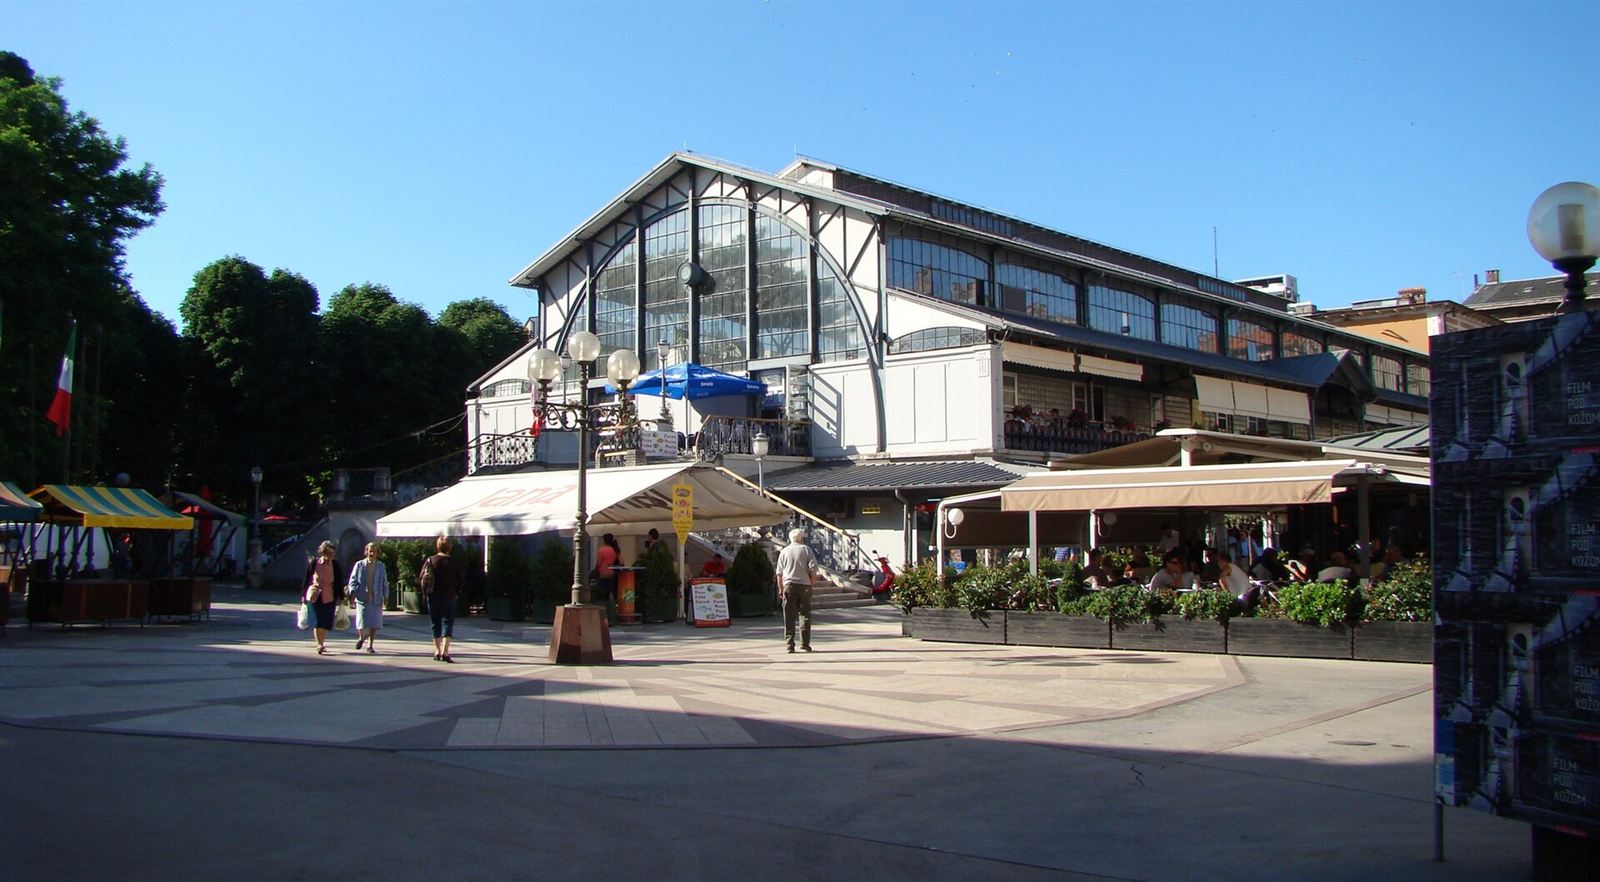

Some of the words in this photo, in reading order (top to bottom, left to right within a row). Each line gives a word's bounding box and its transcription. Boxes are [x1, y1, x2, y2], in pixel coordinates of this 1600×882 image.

[1567, 381, 1591, 393] FILM
[1568, 398, 1584, 409] POD
[1571, 523, 1595, 534] FILM
[1571, 539, 1589, 550] POD
[1575, 665, 1600, 679] FILM
[1575, 681, 1593, 694] POD
[1575, 697, 1600, 712] KOŽO
[1552, 758, 1577, 773] FILM
[1553, 773, 1572, 788] POD
